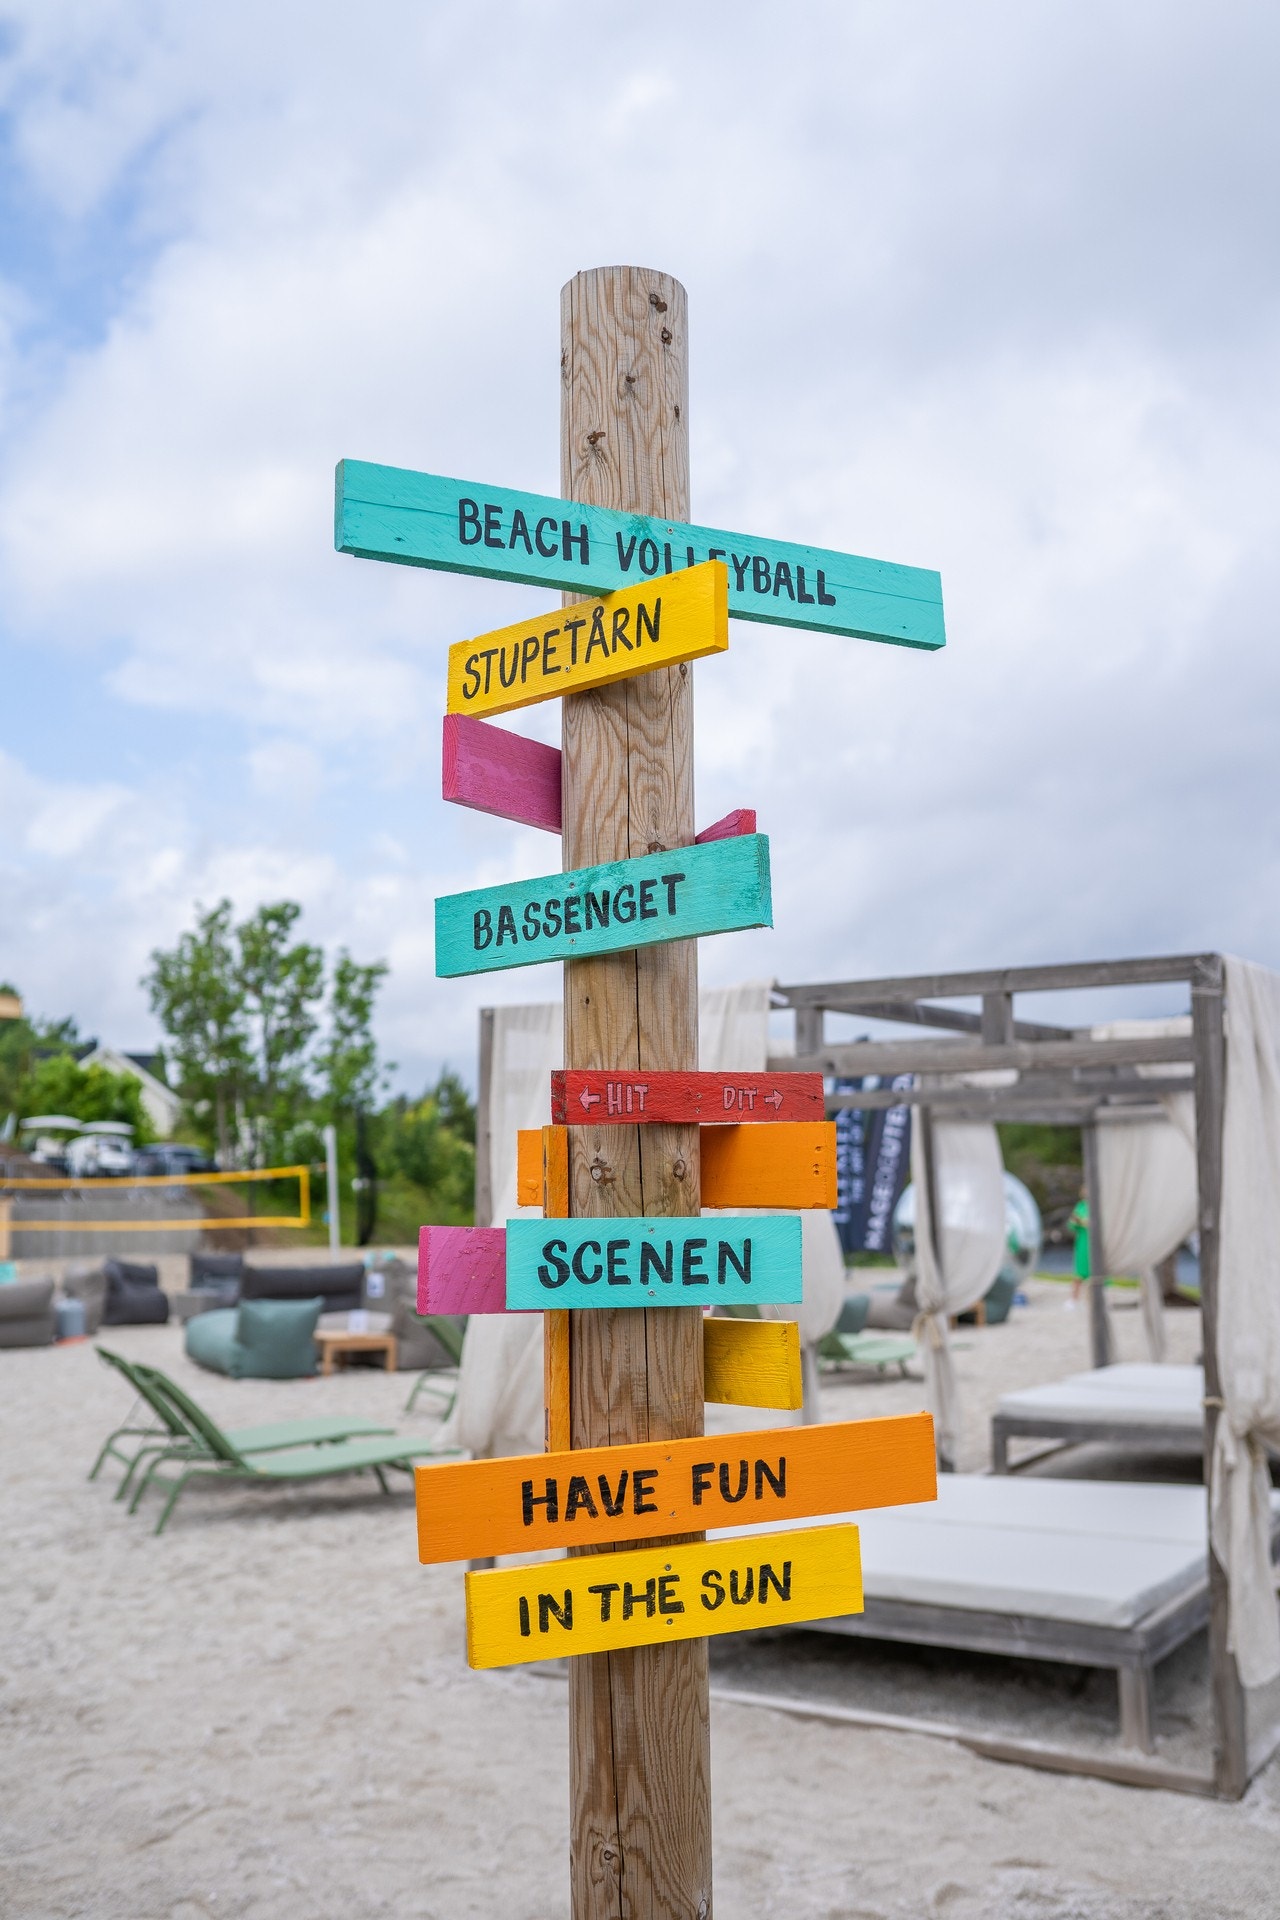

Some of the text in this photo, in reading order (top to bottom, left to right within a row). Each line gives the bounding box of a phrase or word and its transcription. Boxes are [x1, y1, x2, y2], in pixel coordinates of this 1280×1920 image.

[458, 498, 837, 606] BEACH VOLYBALL
[462, 597, 662, 700] STUPETÅRN
[473, 873, 686, 951] BASSENGET
[606, 1082, 758, 1116] HIT DIT
[537, 1238, 752, 1289] SCENEN
[521, 1456, 787, 1526] HAVE FUN
[519, 1561, 792, 1637] IN THE SUN
